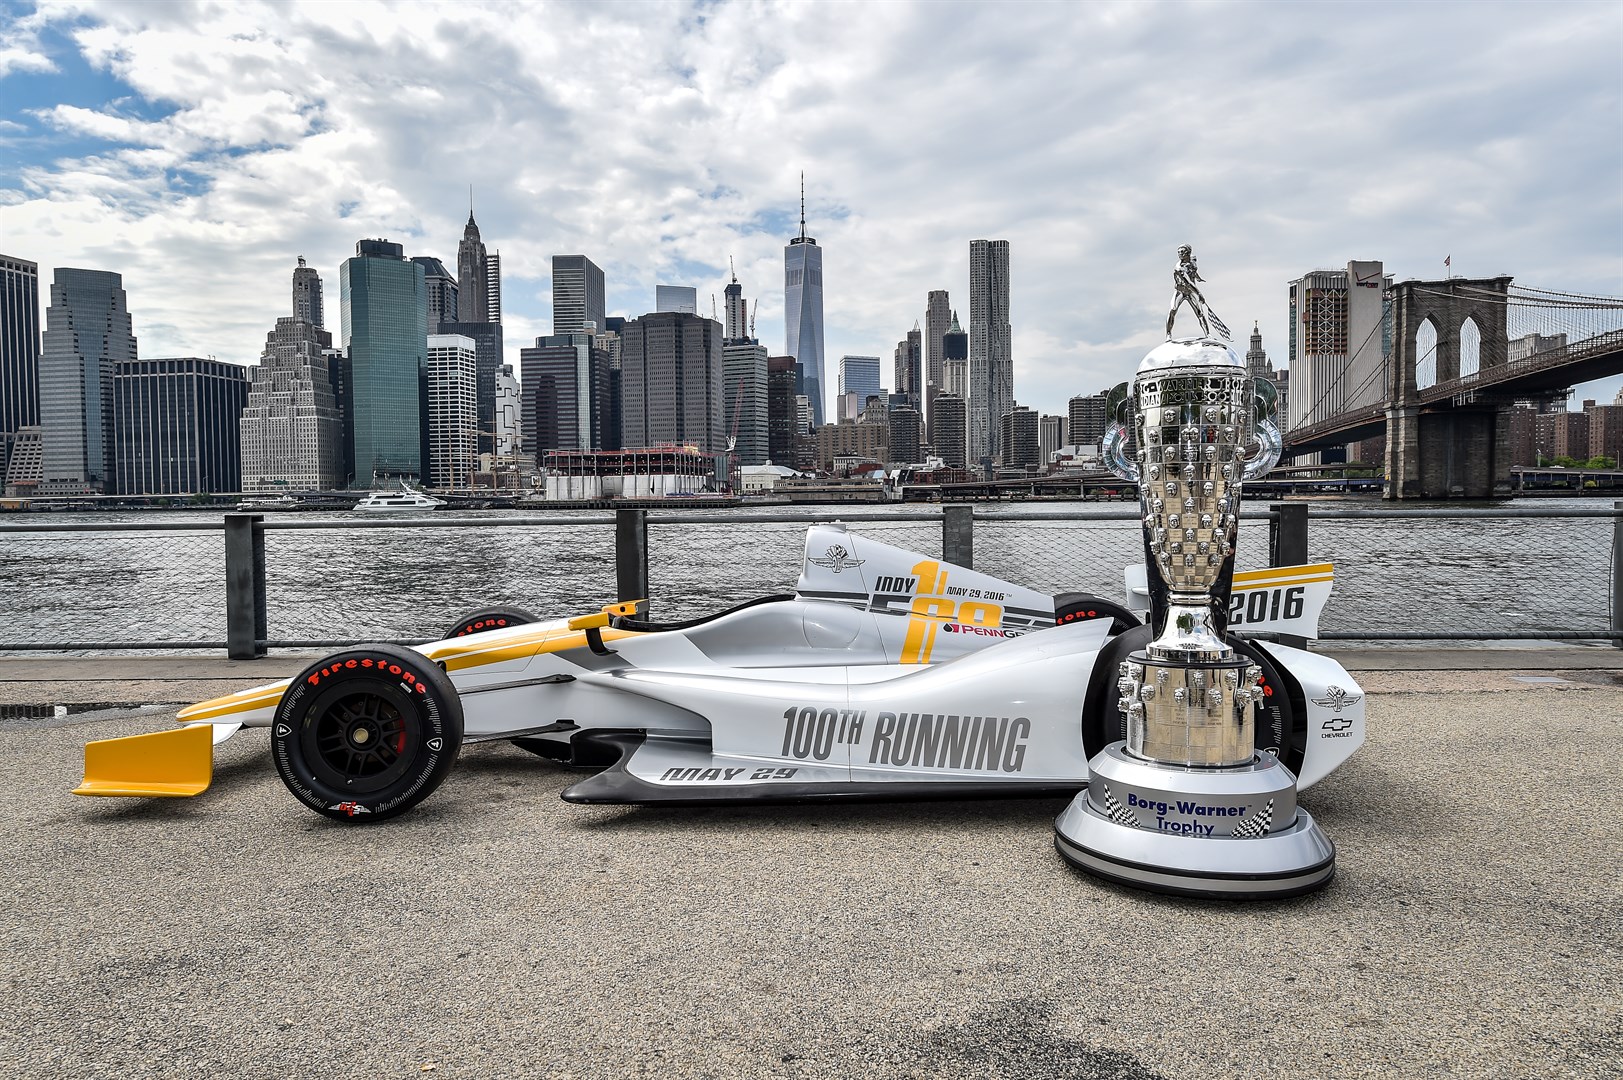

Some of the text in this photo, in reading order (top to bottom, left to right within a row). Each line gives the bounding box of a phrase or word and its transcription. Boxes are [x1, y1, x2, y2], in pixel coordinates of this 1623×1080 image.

[874, 576, 916, 593] INDY
[946, 586, 968, 597] MAY
[983, 590, 1005, 601] 2016
[1228, 587, 1304, 625] 2016
[308, 658, 427, 694] Firestone
[868, 711, 1031, 773] RUNNING
[660, 768, 798, 780] MAY 29
[1128, 793, 1246, 816] Borg-Warner
[1156, 816, 1214, 836] Trophy
